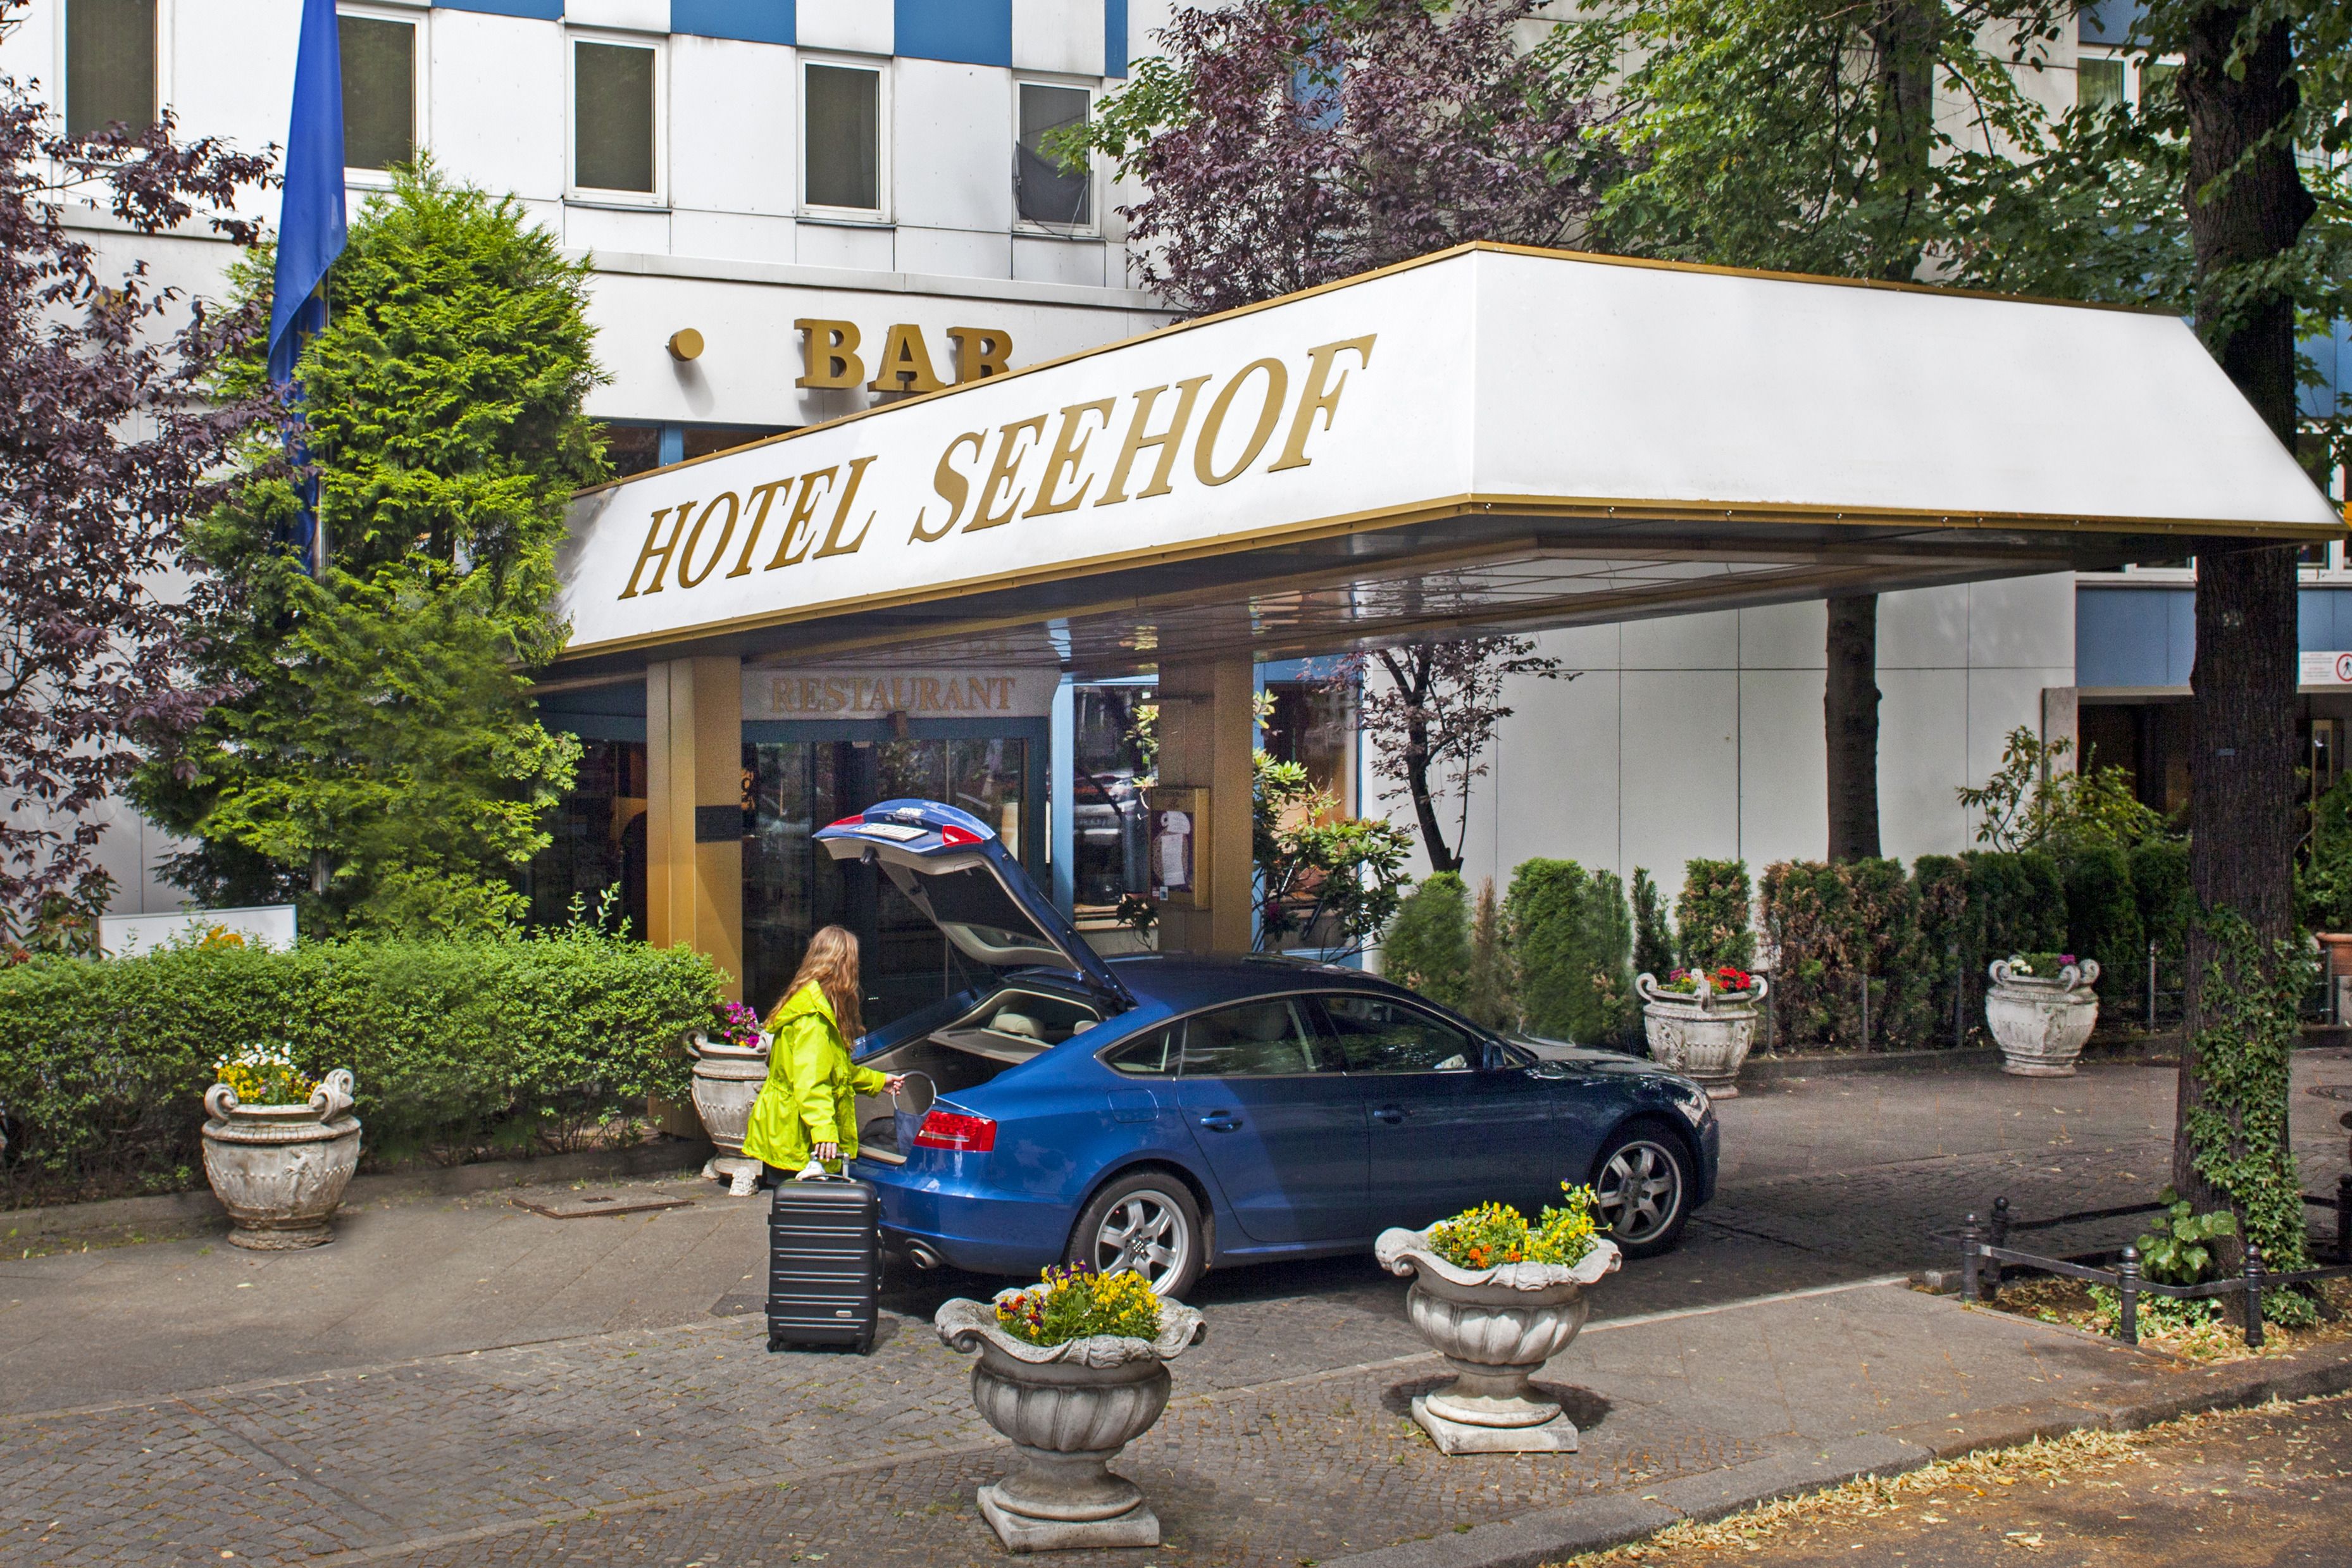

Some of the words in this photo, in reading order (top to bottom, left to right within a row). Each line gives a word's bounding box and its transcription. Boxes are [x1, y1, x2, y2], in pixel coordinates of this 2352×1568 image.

[794, 318, 1012, 392] BAR
[618, 455, 877, 600] HOTEL
[908, 333, 1378, 544] SEEHOF
[770, 676, 1016, 713] RESTAURANT
